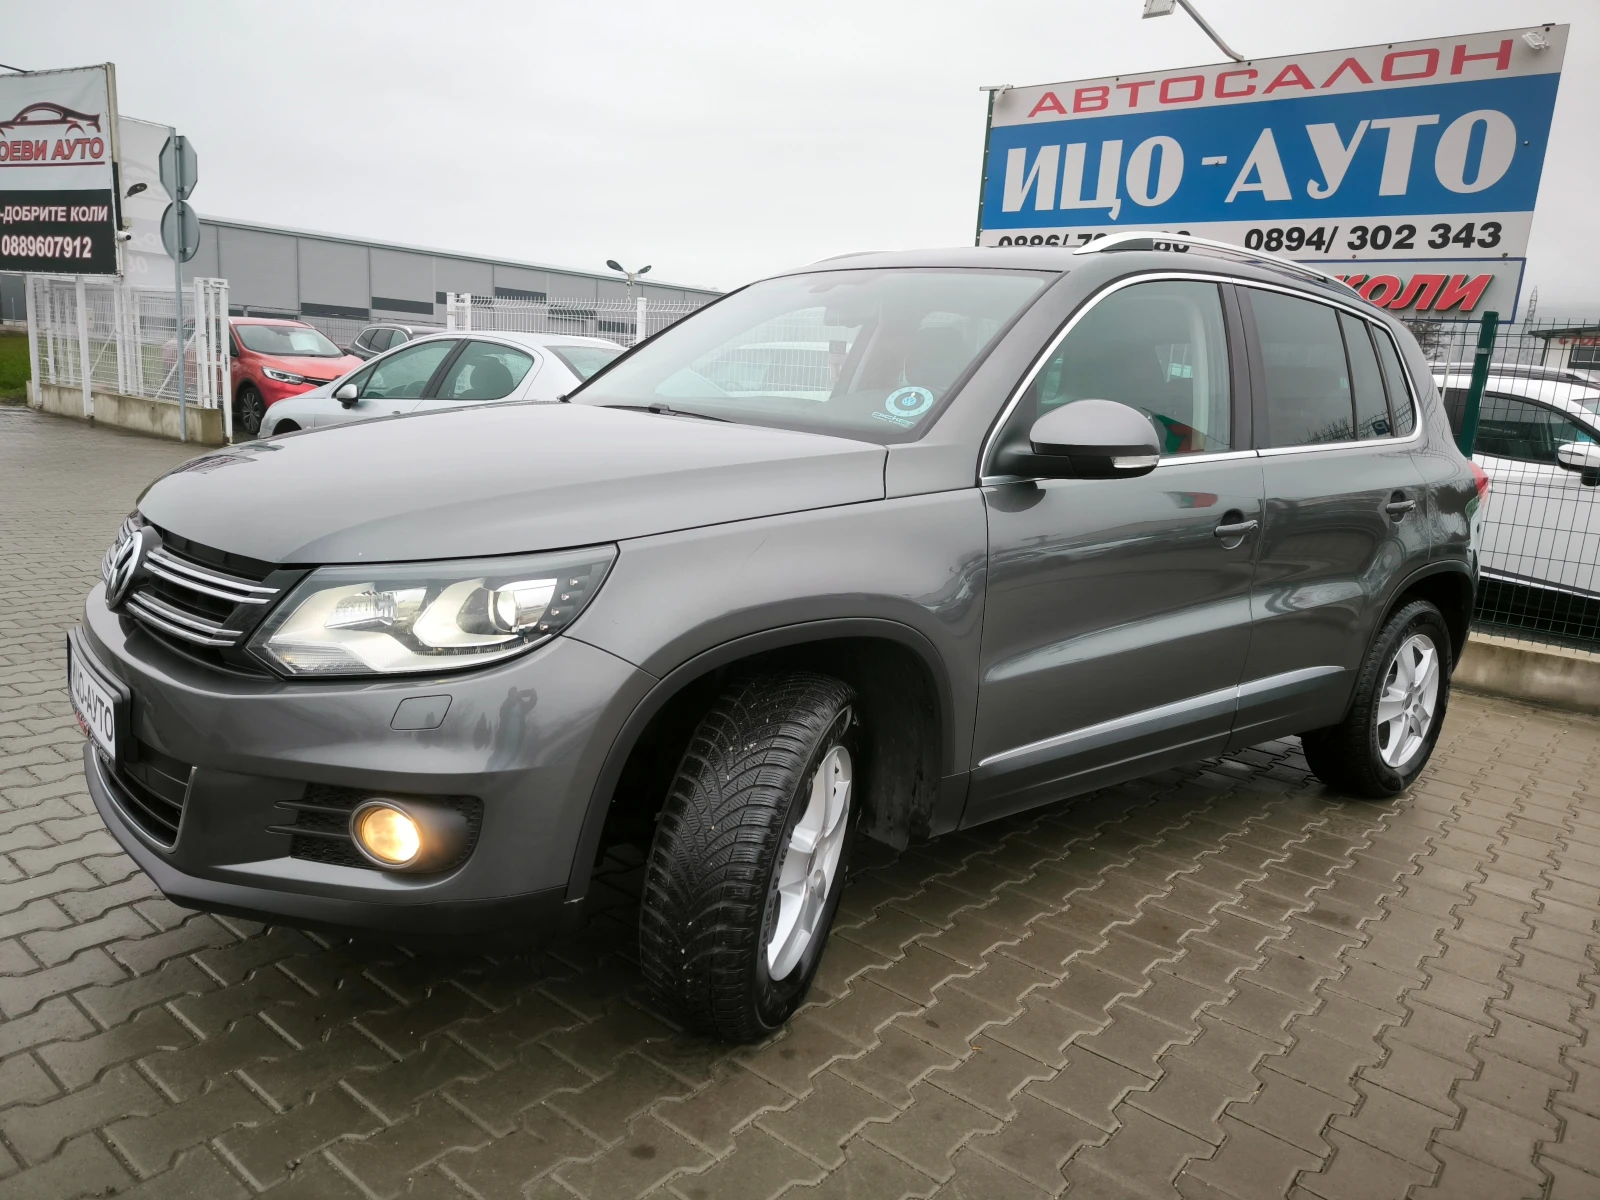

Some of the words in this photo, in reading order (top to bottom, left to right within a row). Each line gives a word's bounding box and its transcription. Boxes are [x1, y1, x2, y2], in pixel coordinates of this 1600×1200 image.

[1027, 39, 1514, 118] АВТОСАЛОН
[51, 137, 104, 160] АУТО
[70, 206, 108, 222] КОЛИ
[1, 235, 92, 258] 0889607912
[1244, 226, 1337, 255] 0894/
[1347, 224, 1415, 251] 302
[1427, 221, 1503, 250] 343
